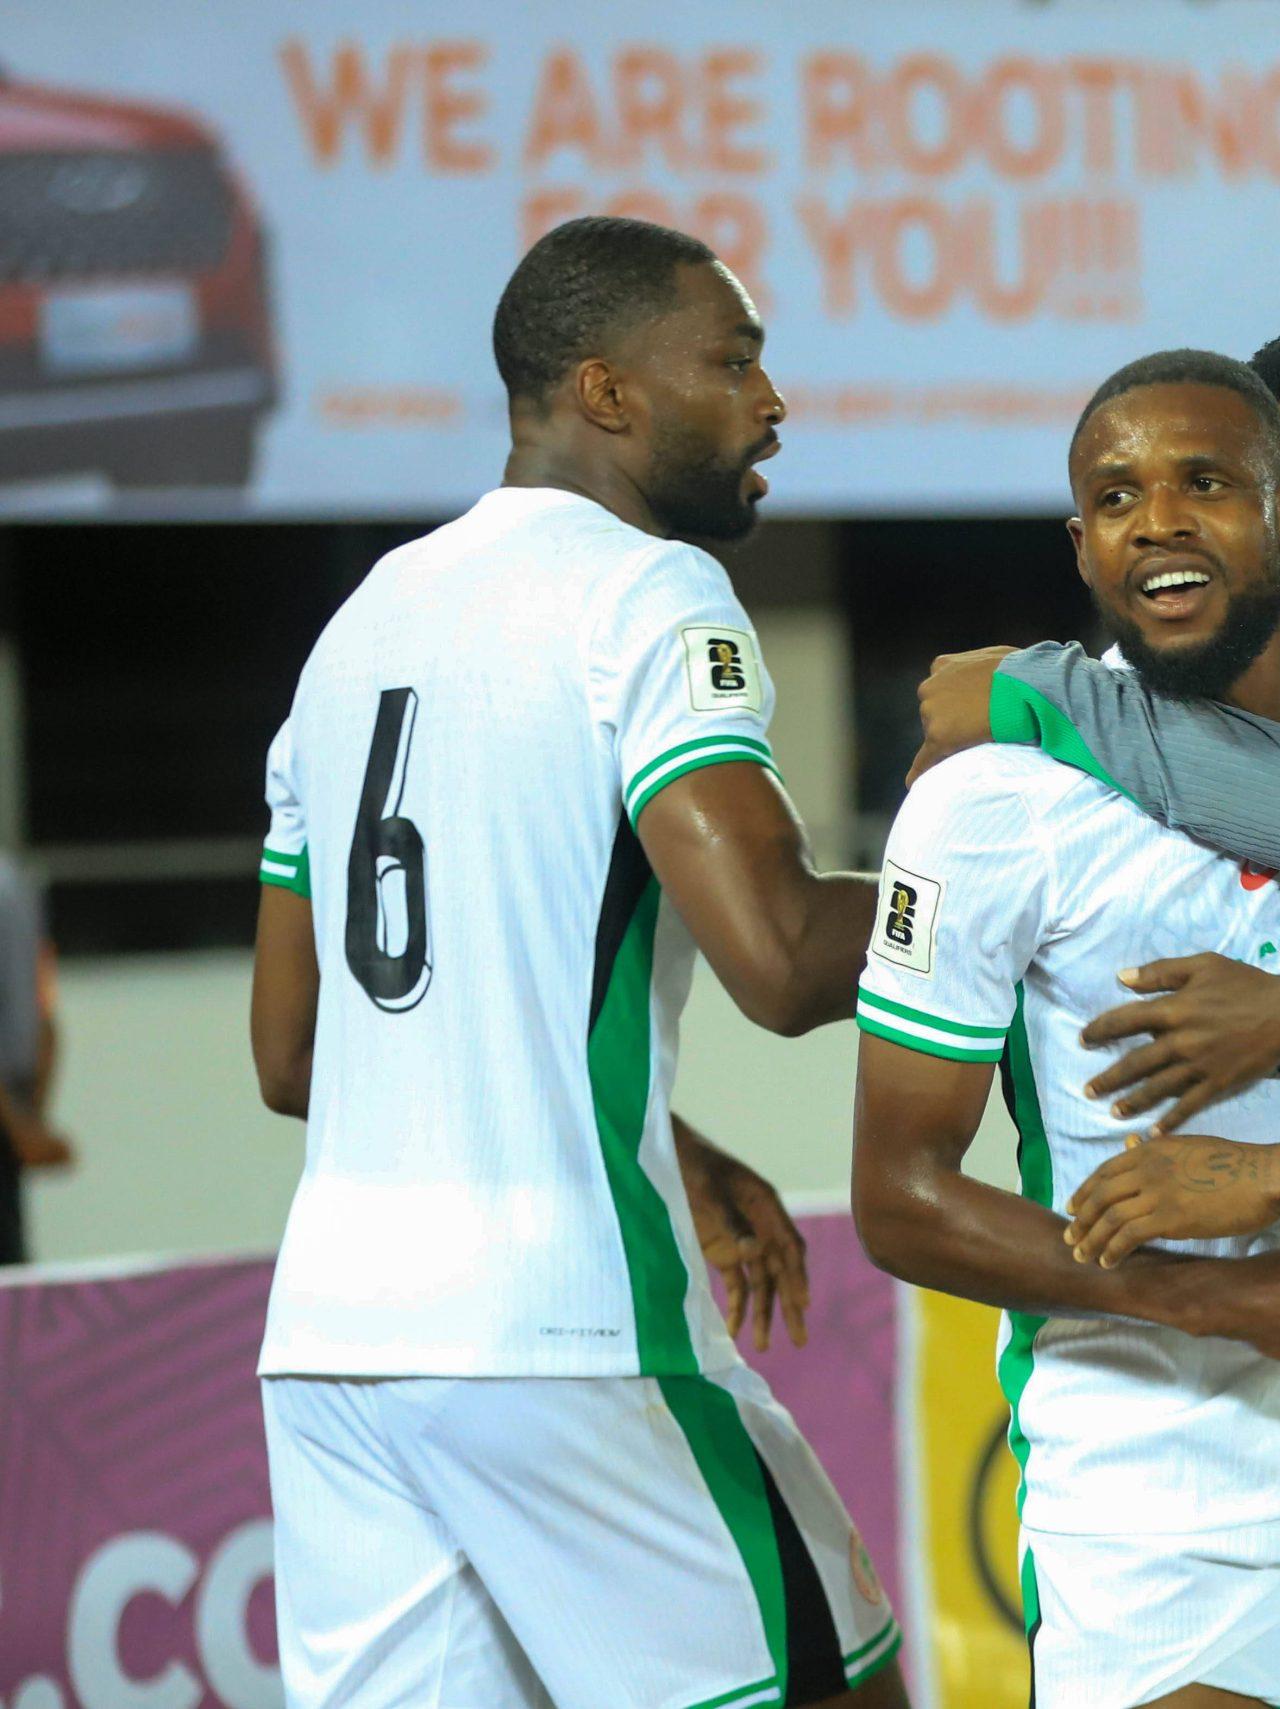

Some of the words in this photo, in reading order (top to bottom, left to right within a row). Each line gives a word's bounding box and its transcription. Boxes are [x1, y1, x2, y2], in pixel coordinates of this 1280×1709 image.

[281, 38, 492, 172] WE
[521, 42, 774, 176] ARE
[345, 686, 432, 1014] 6
